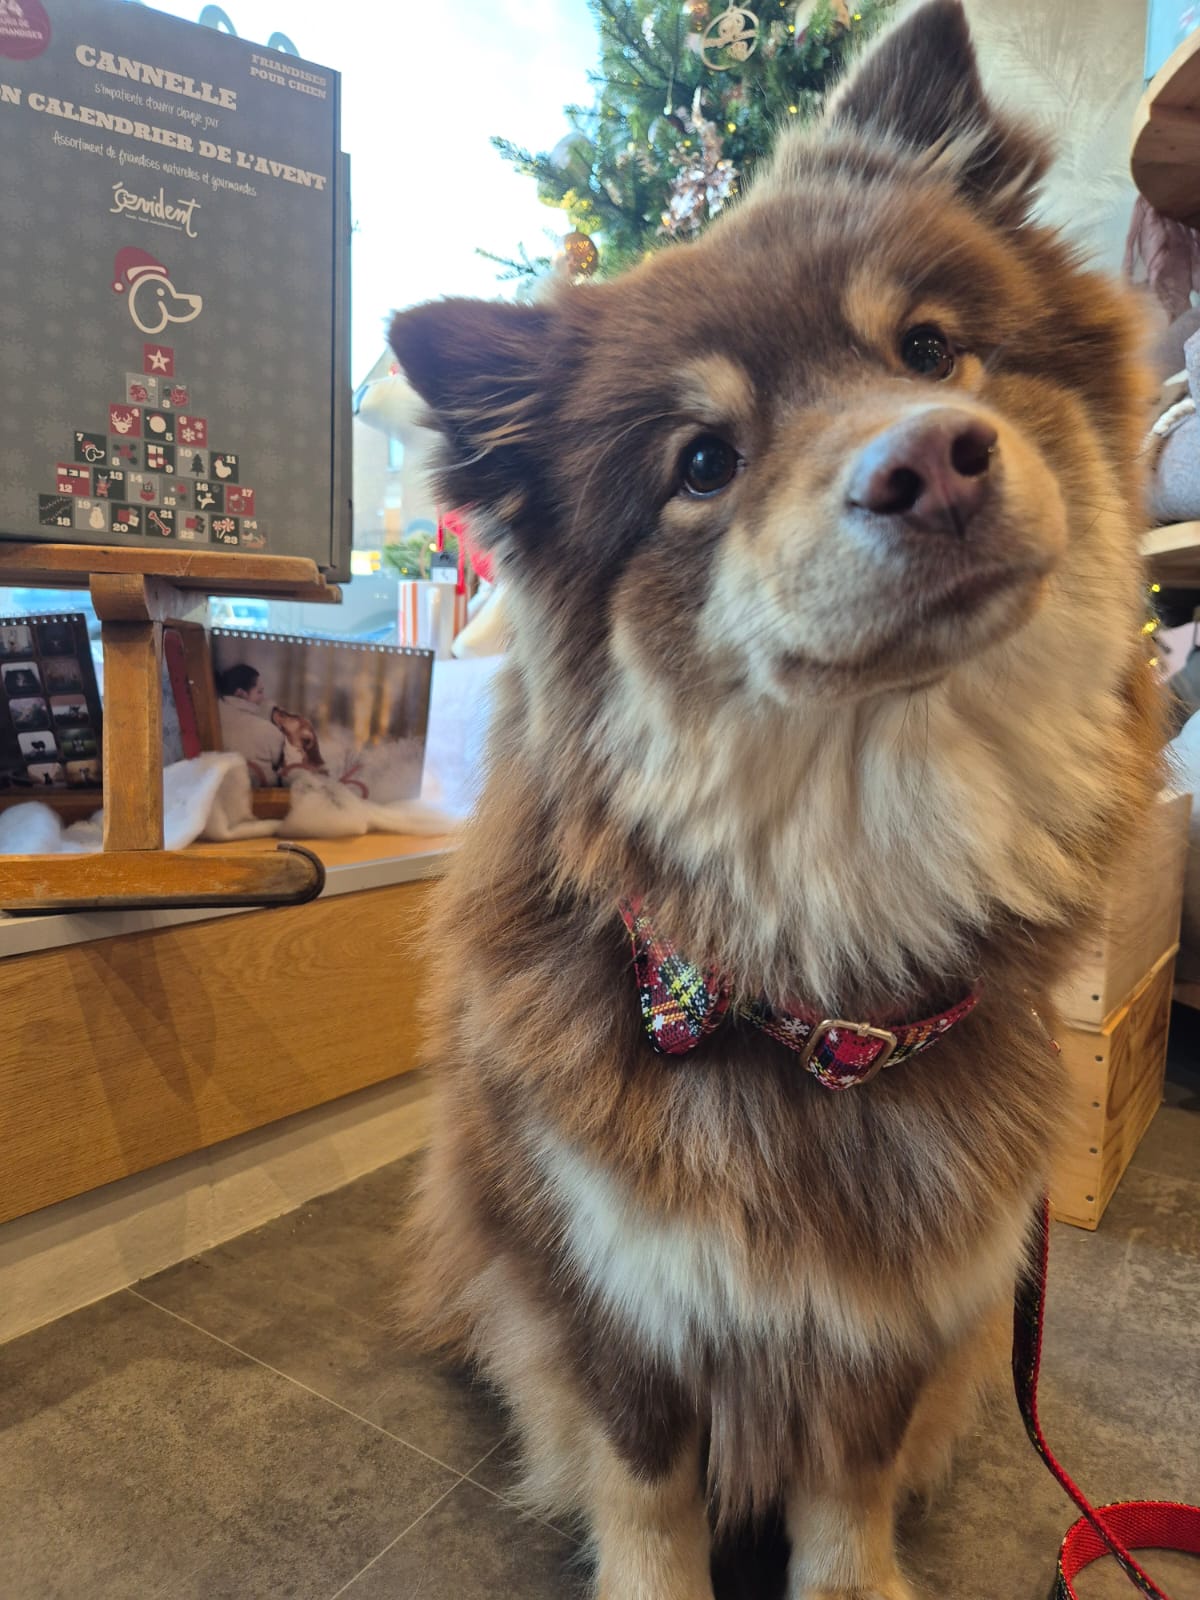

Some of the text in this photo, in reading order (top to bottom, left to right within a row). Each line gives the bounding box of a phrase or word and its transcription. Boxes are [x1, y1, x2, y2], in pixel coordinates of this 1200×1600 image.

[251, 54, 327, 86] FRIANDISES
[75, 44, 237, 111] CANNELLE
[250, 67, 327, 99] POUR CHIEN
[28, 92, 194, 153] CALENDRIER
[199, 140, 232, 163] DE
[236, 150, 327, 190] L'AVENT
[52, 130, 257, 197] Assortiment de friandises naturelles et gourmandes
[76, 432, 84, 442] 7
[179, 447, 193, 458] 10
[226, 455, 237, 465] 11
[165, 464, 174, 474] 9
[109, 470, 124, 481] 13
[129, 474, 143, 483] 14
[58, 483, 73, 494] 12
[195, 481, 209, 492] 16
[240, 488, 254, 498] 17
[77, 499, 92, 510] 19
[163, 496, 177, 507] 15
[159, 510, 173, 519] 21
[56, 516, 72, 528] 18
[112, 521, 129, 534] 20
[243, 519, 258, 530] 24
[179, 529, 195, 540] 22
[223, 534, 239, 545] 23
